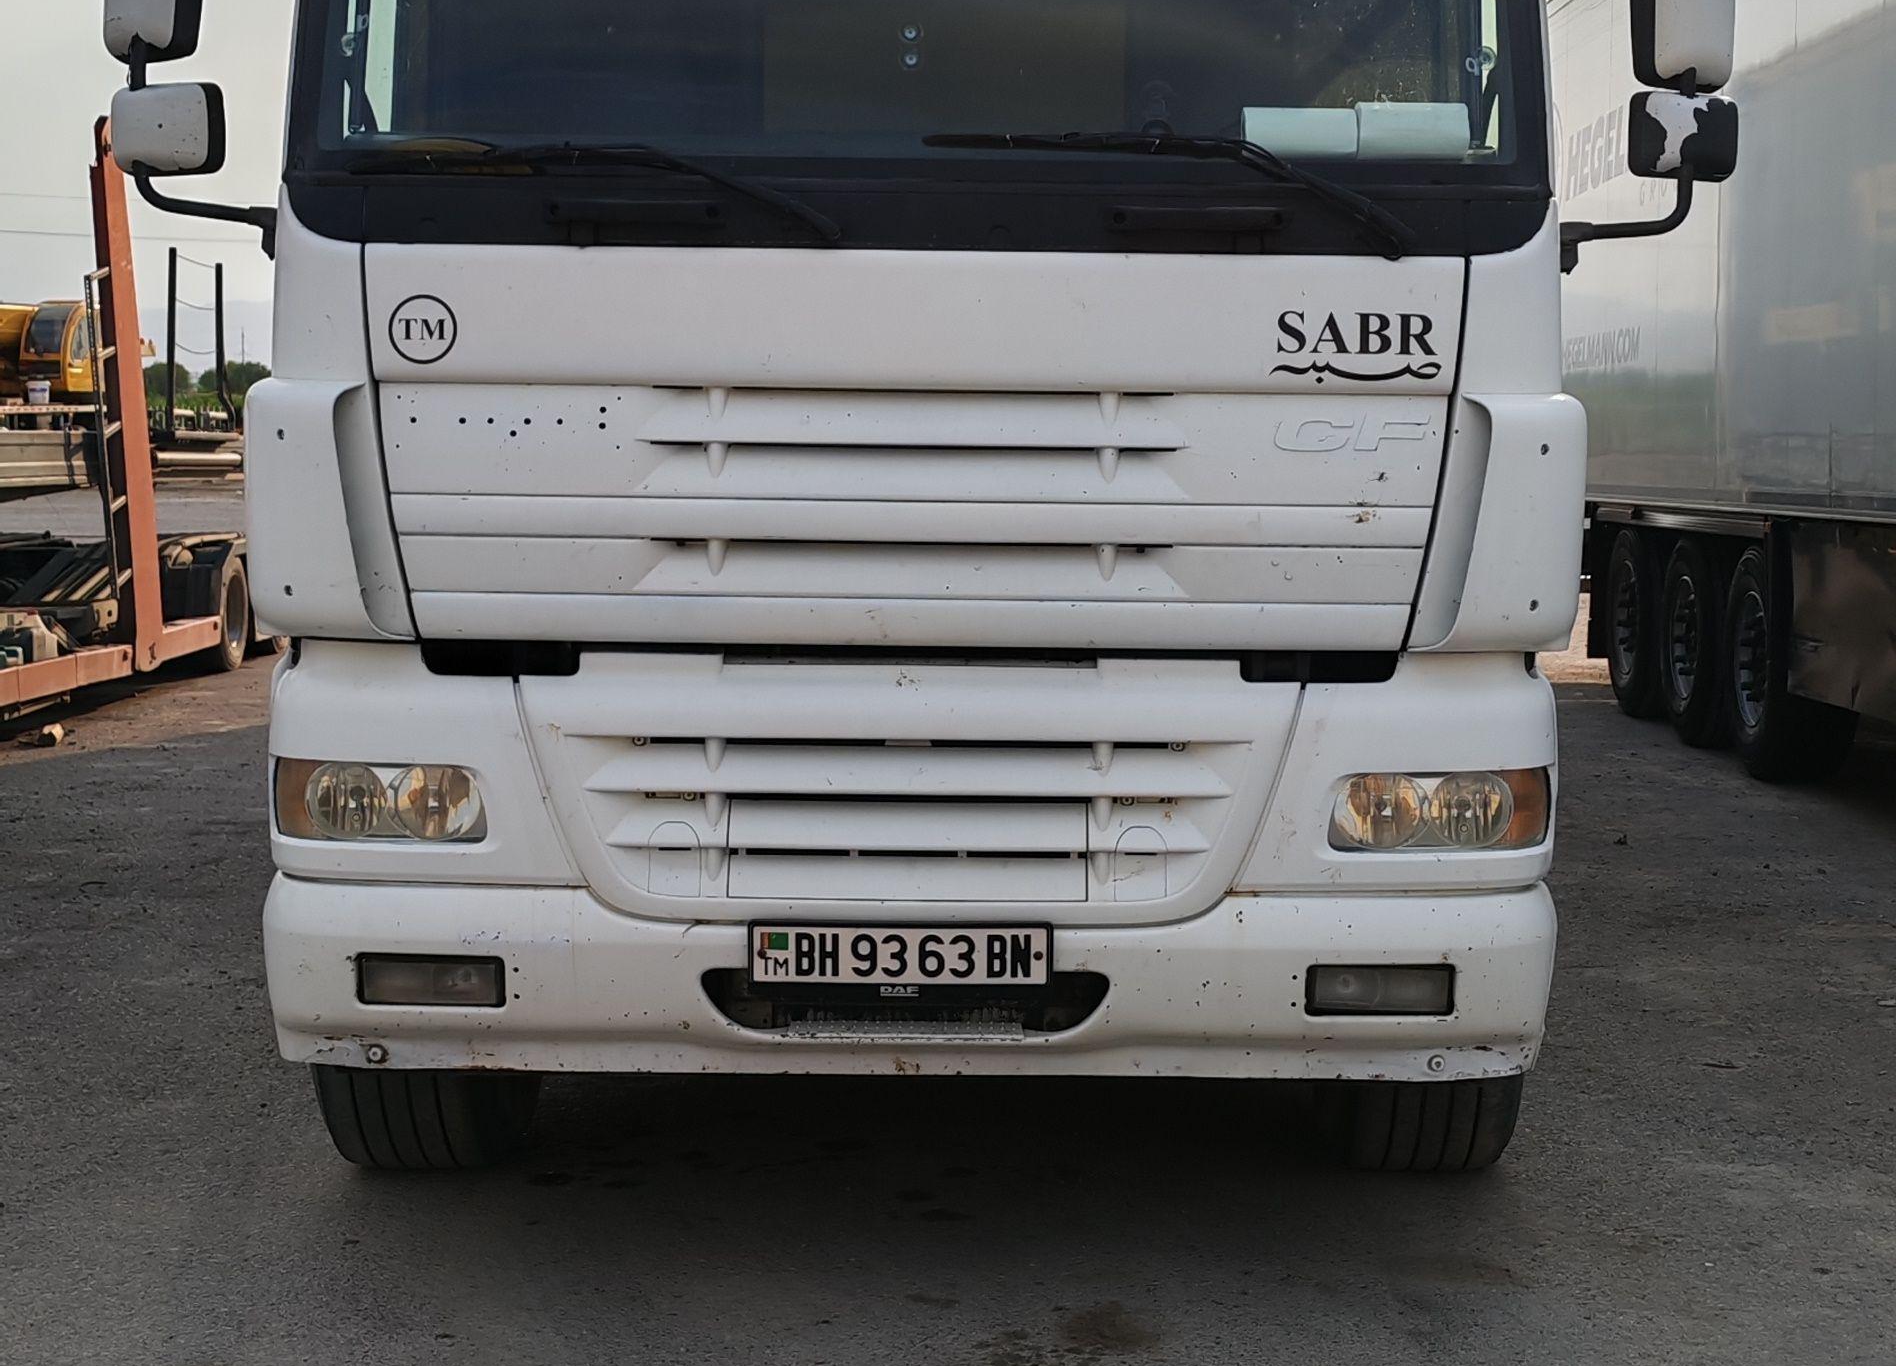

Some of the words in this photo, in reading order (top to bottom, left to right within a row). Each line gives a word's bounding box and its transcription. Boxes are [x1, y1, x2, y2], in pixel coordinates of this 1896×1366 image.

[1566, 105, 1626, 201] HEGEL
[398, 318, 447, 340] TM
[1277, 310, 1438, 355] SABR
[1274, 410, 1431, 452] CF
[761, 956, 789, 977] TM
[795, 932, 839, 977] BH
[986, 934, 1032, 978] BN
[880, 985, 919, 994] DAF
